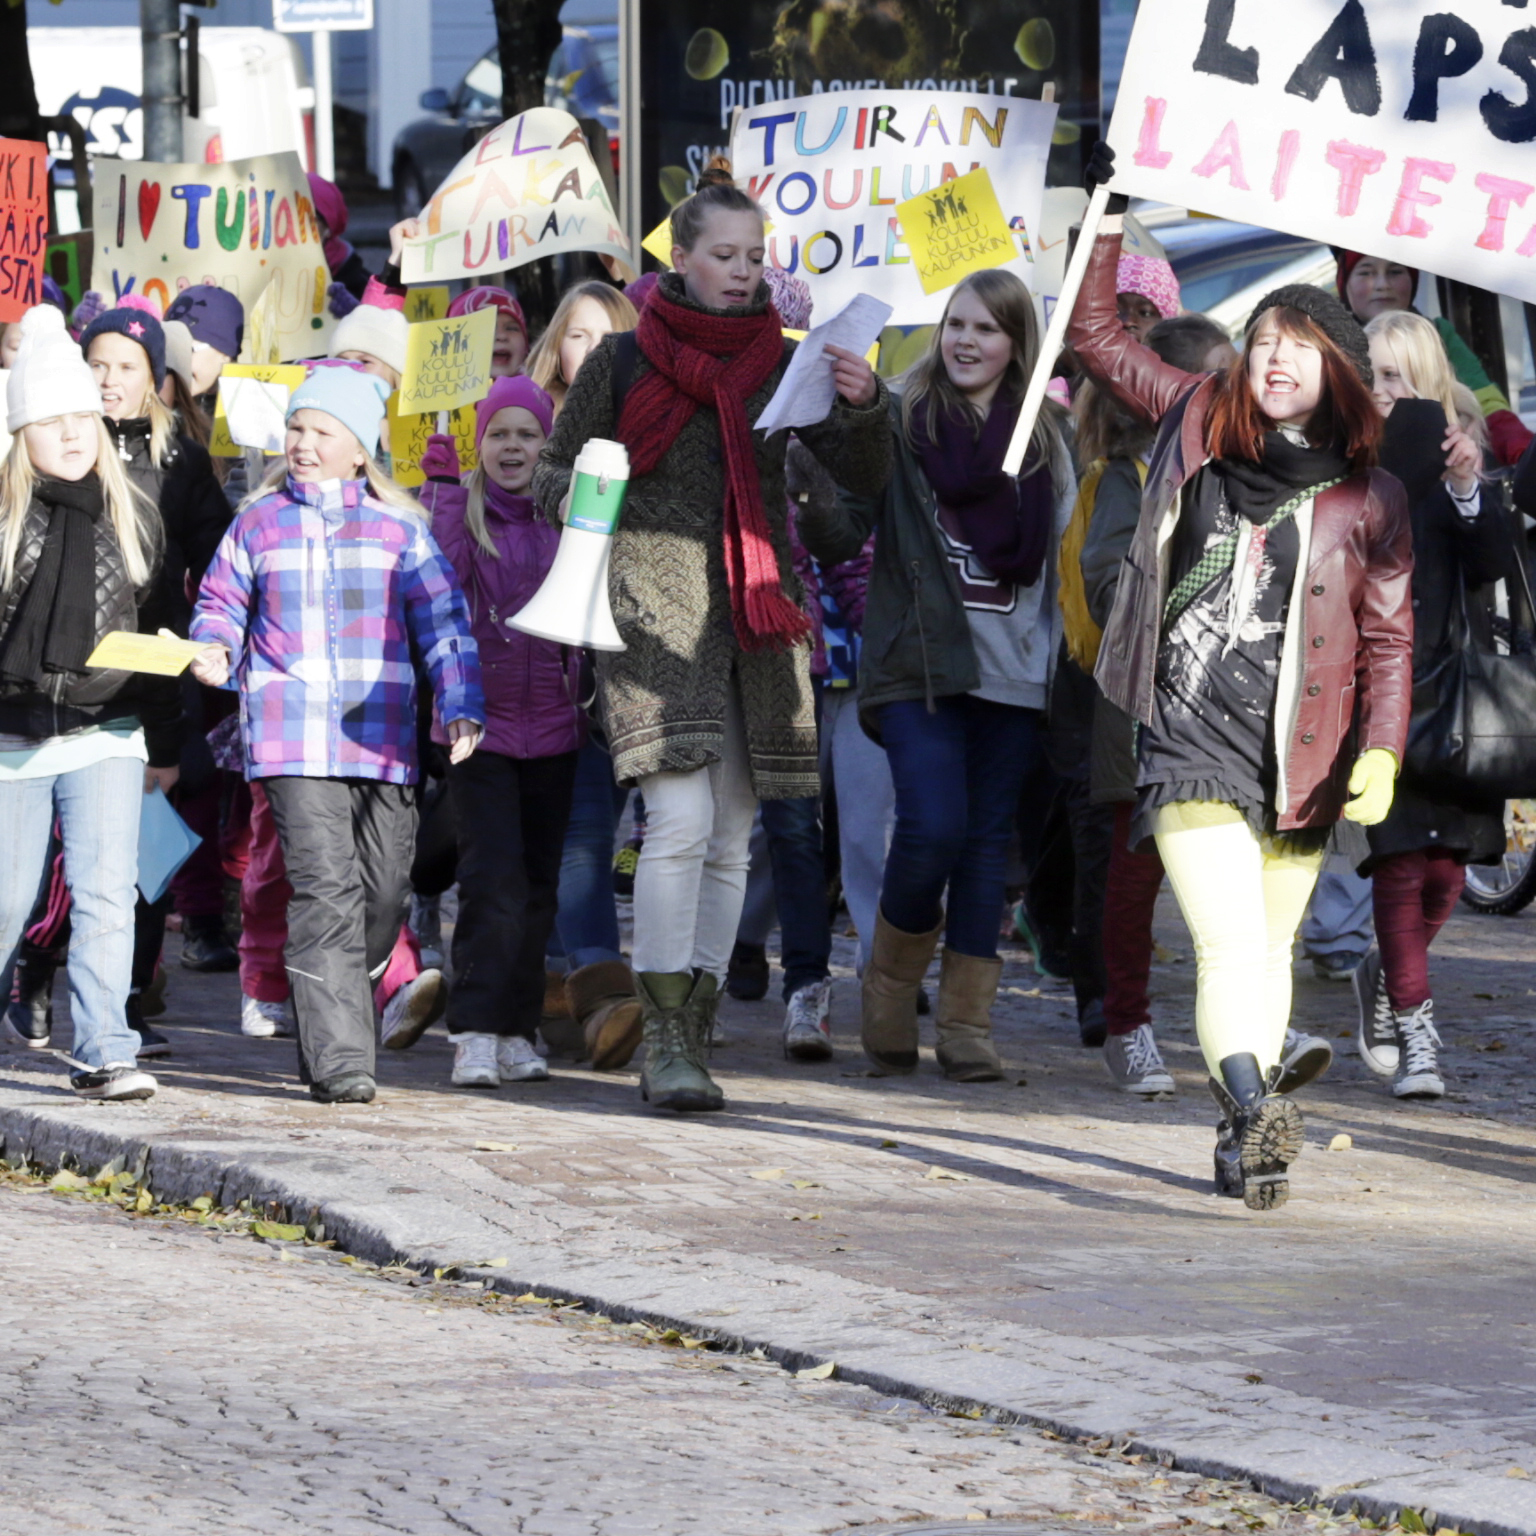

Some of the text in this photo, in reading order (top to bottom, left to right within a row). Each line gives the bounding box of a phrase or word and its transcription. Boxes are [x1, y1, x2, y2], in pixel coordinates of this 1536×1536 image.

[748, 104, 1009, 166] TUIRAN
[405, 209, 587, 273] TUIRAN
[926, 212, 979, 244] KOULU
[927, 225, 989, 260] KUULUU
[920, 233, 1007, 280] KAUPUNKIN
[416, 364, 476, 387] KUULUU
[422, 351, 474, 372] KOULU
[402, 373, 485, 402] KAUPUNKIN
